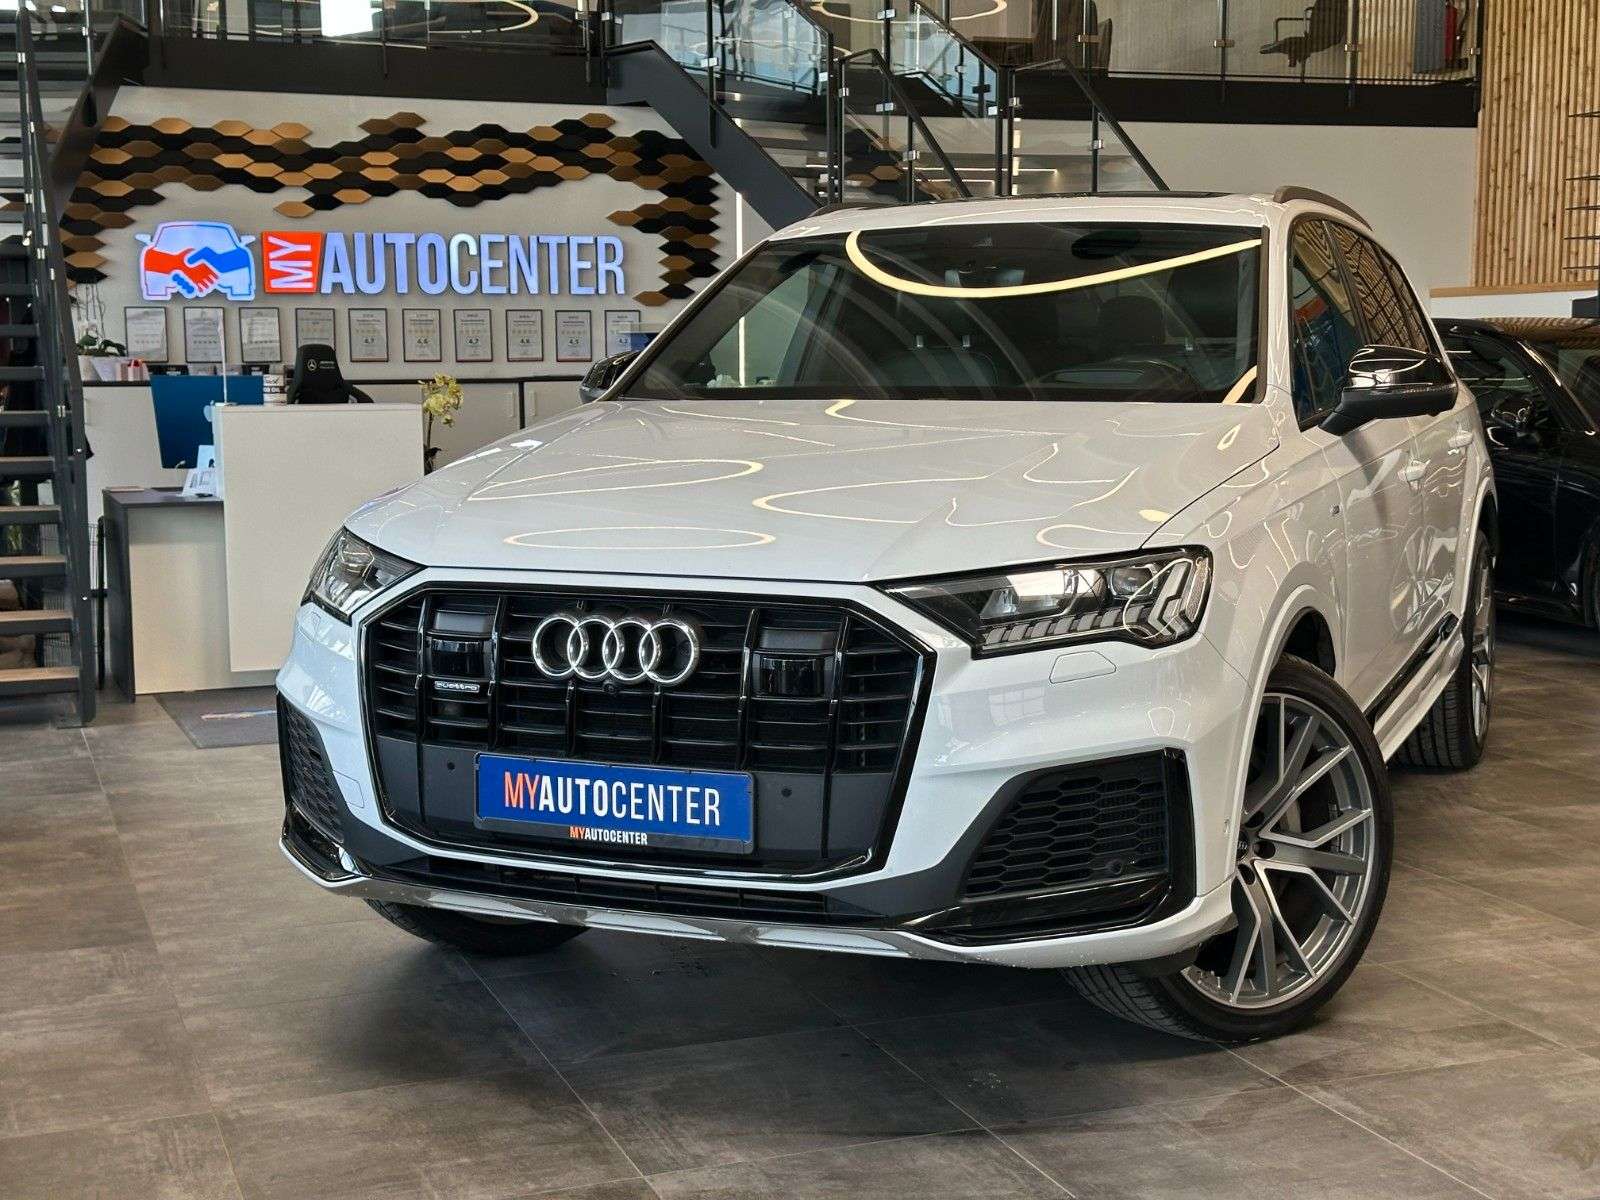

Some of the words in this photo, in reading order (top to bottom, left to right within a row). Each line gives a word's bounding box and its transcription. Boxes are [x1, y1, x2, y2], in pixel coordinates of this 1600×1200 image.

[268, 236, 313, 288] MY
[320, 232, 625, 295] AUTOCENTER
[504, 771, 721, 826] MYAUTOCENTER
[569, 826, 648, 845] MYAUTOCENTER
